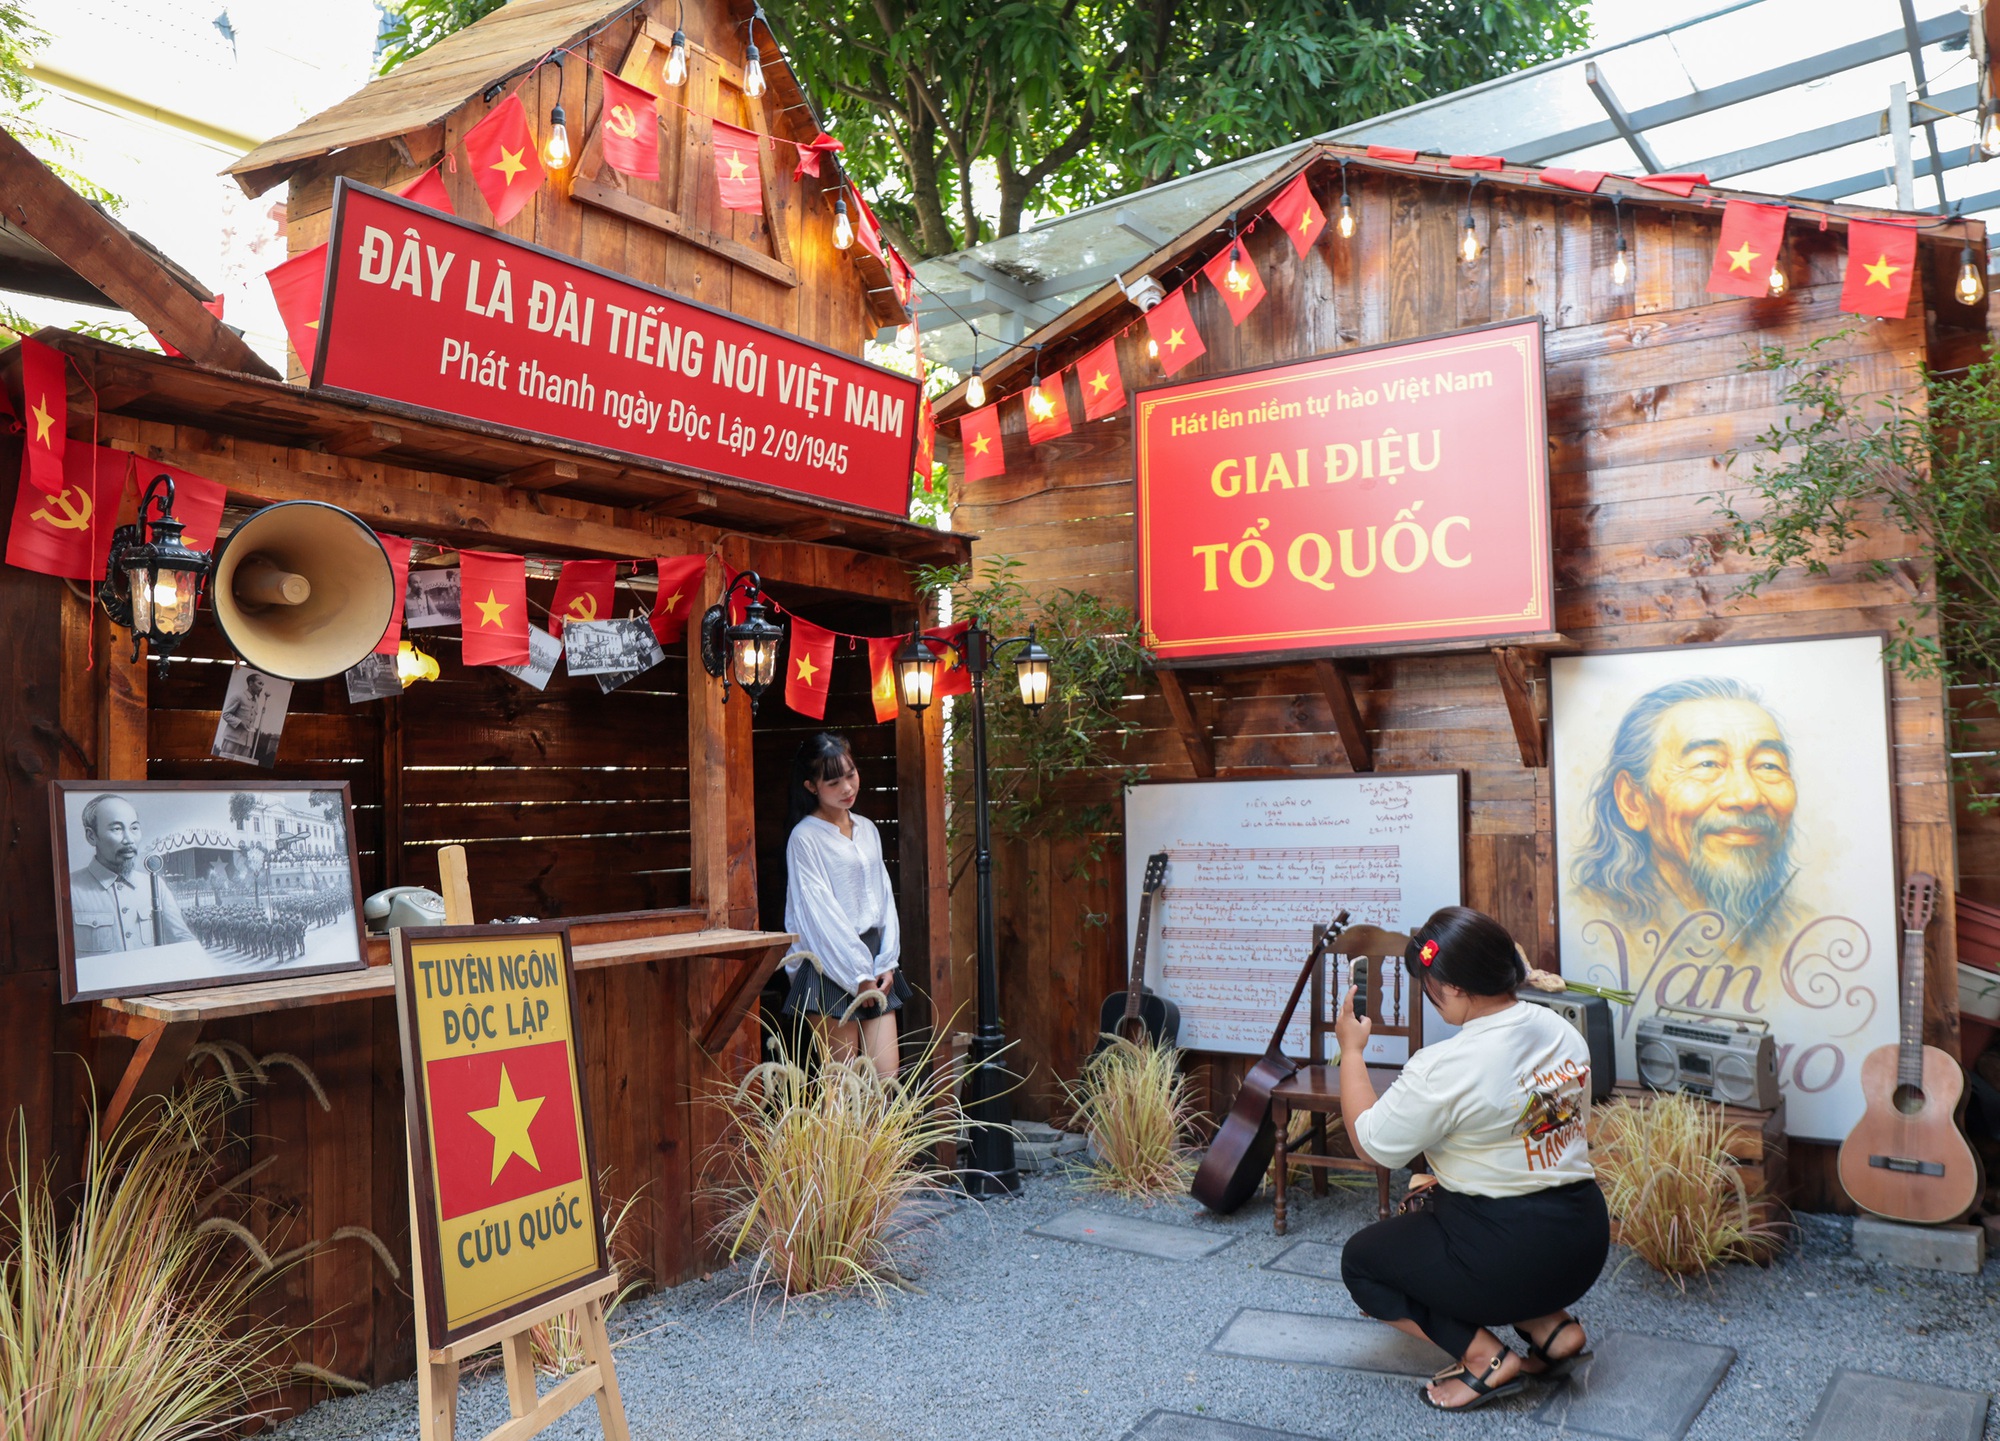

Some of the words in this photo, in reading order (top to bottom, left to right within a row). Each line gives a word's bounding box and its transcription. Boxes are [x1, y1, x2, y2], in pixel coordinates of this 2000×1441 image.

[358, 225, 455, 302] ĐÂY
[465, 259, 514, 324] LÀ
[527, 280, 595, 347] ĐÀI
[606, 304, 704, 379] TIẾNG
[712, 341, 768, 398] NÓI
[777, 361, 839, 419] VIỆT
[844, 382, 905, 438] NAM
[440, 337, 510, 391] Phát
[518, 358, 596, 412] thanh
[603, 390, 662, 435] ngày
[668, 399, 711, 442] Độc
[718, 412, 756, 458] Lập
[762, 424, 849, 475] 2/9/1945
[1171, 412, 1208, 437] Hát
[1212, 407, 1243, 431] lên
[1247, 398, 1302, 426] niềm
[1306, 394, 1331, 416] tự
[1336, 384, 1379, 411] hào
[1383, 375, 1430, 404] Việt
[1435, 370, 1493, 395] Nam
[1210, 448, 1310, 498] GIAI
[1324, 427, 1442, 485] ĐIỆU
[1192, 517, 1275, 592] TỔ
[1287, 500, 1472, 591] QUỐC
[418, 953, 496, 999] TUYÊN
[498, 949, 559, 992] NGÔN
[1581, 910, 1765, 1040] Văn
[442, 1002, 498, 1049] ĐỘC
[506, 996, 550, 1041] LẬP
[457, 1218, 511, 1270] CỨU
[518, 1191, 584, 1251] QUỐC
